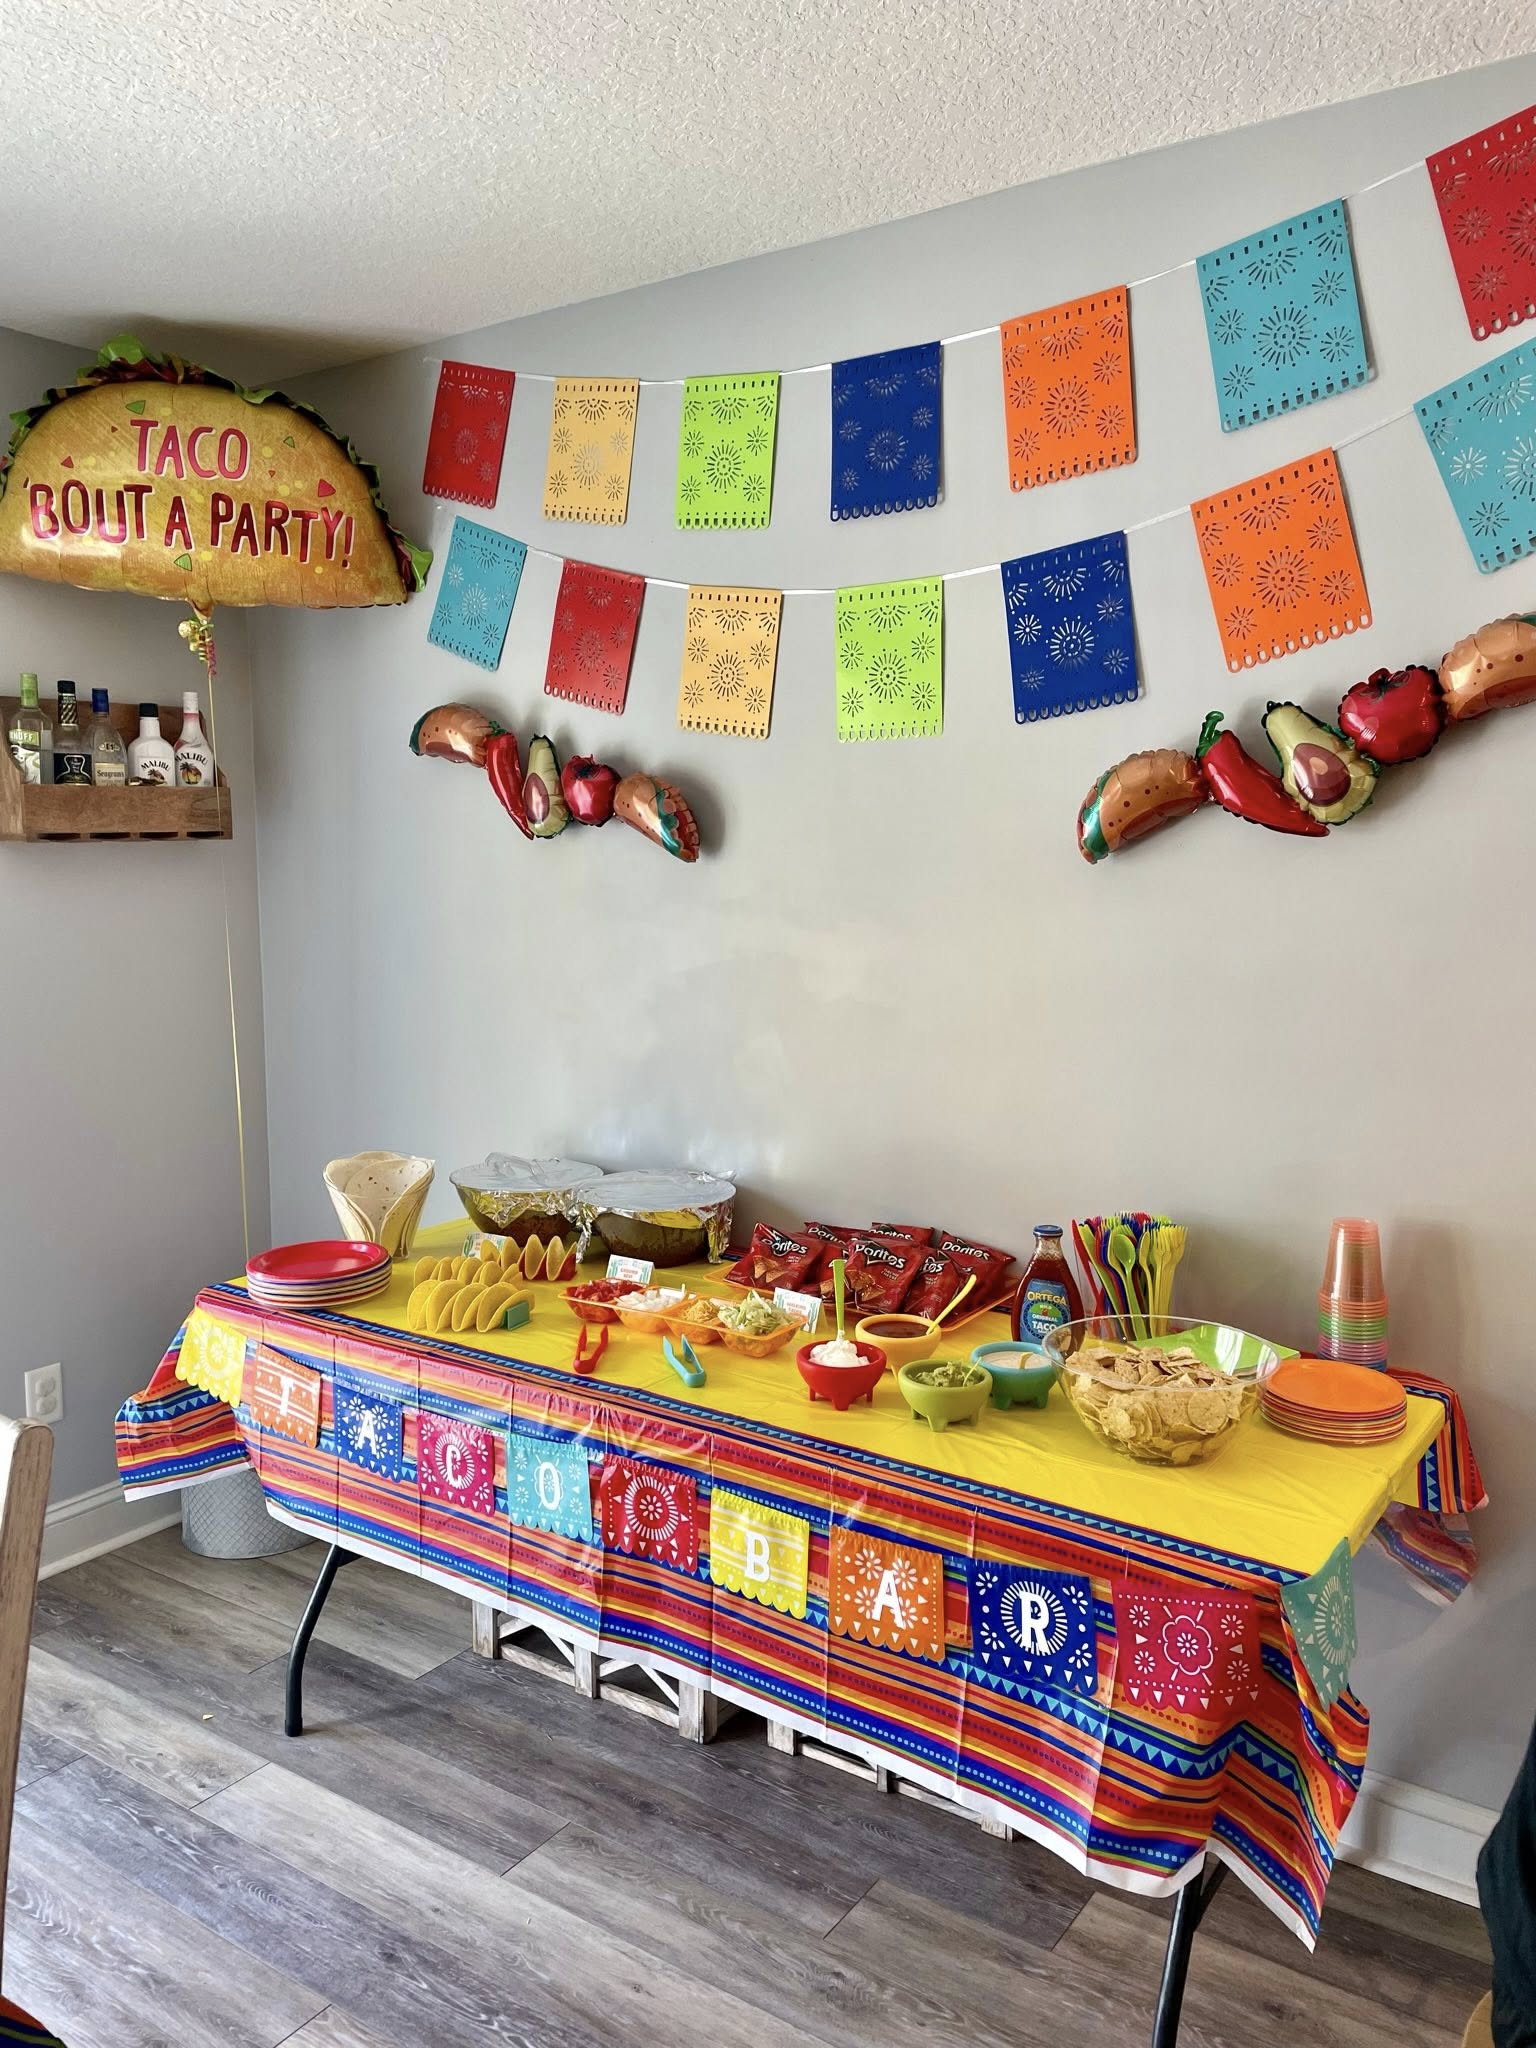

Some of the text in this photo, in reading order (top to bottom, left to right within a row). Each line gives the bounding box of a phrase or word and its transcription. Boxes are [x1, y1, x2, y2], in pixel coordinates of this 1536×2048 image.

[129, 419, 249, 480] TACO
[23, 478, 355, 569] 'BOUT A PARTY!
[141, 759, 170, 771] MALIBU
[175, 752, 208, 765] MALIBU
[761, 1238, 808, 1254] Doritos
[942, 1241, 990, 1260] Doritos
[855, 1243, 906, 1269] Doritos
[1027, 1291, 1067, 1306] ORTEGA
[1032, 1320, 1057, 1331] TACO
